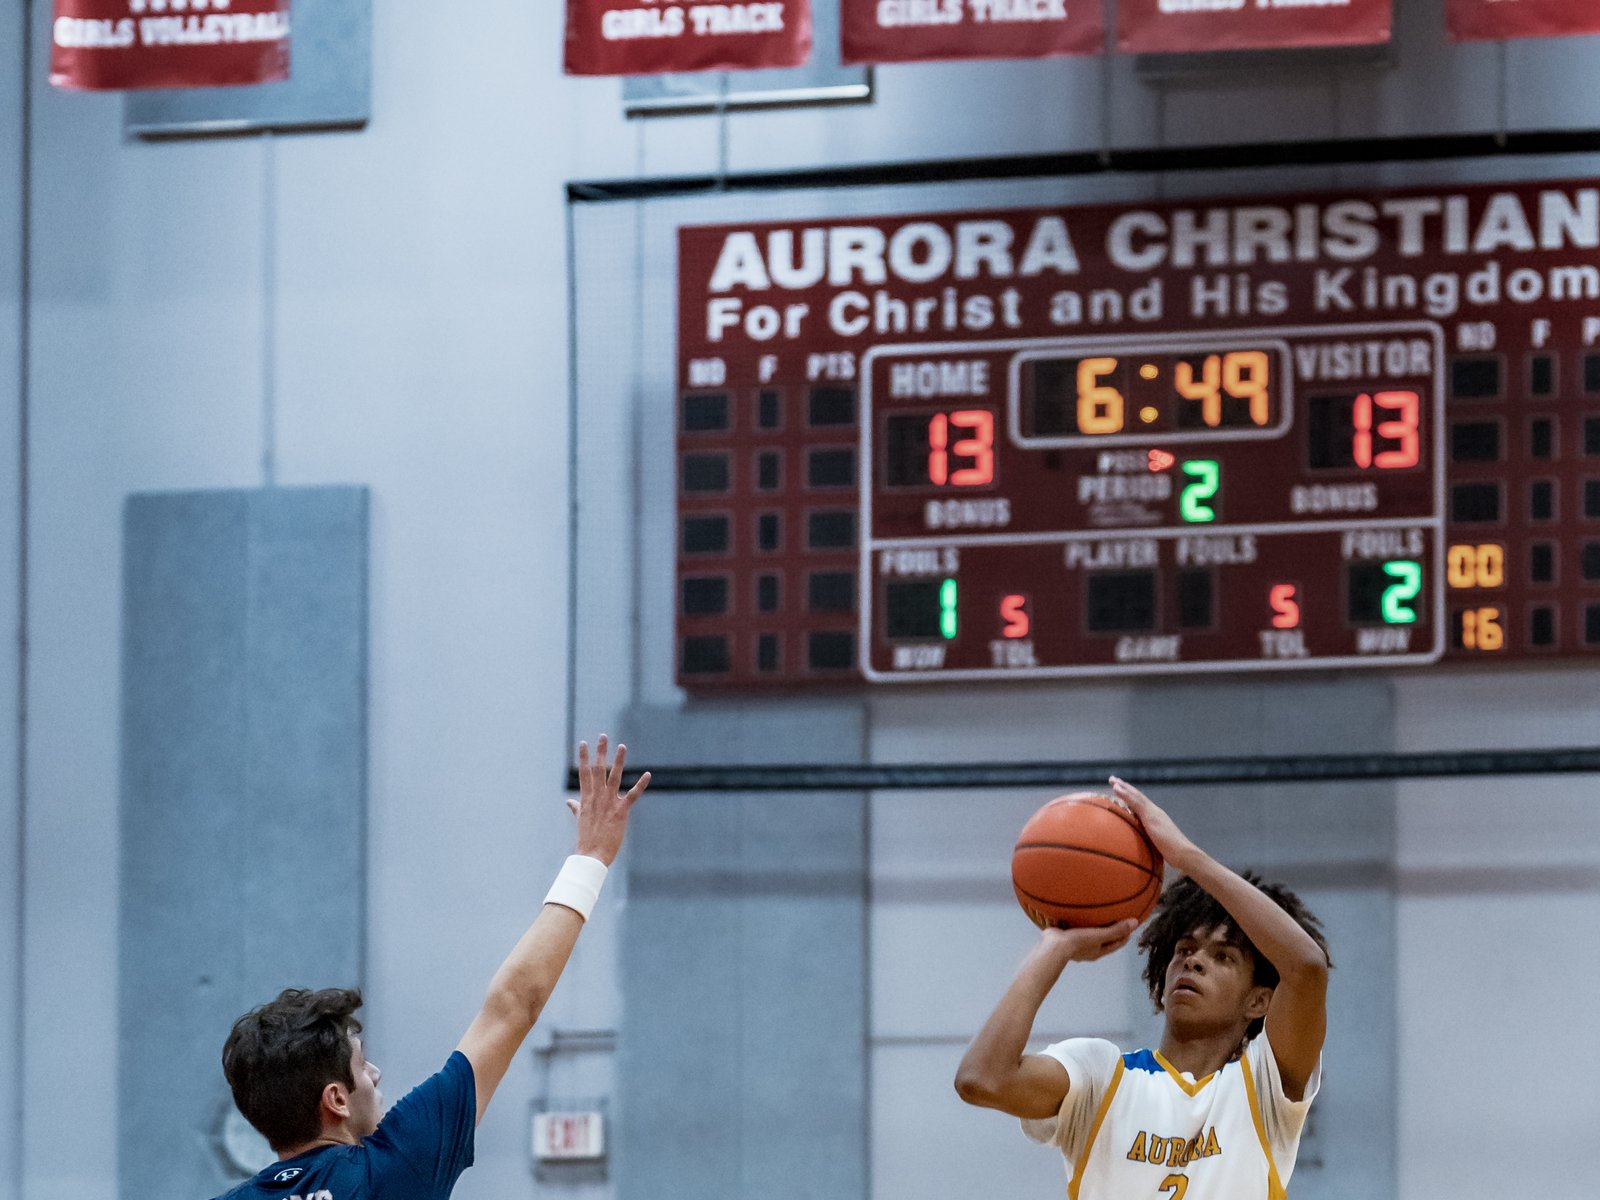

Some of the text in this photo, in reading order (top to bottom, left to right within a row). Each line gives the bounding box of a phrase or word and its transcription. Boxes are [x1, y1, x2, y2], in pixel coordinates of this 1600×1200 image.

[53, 16, 135, 48] GIRLS
[601, 3, 784, 40] GIRLS TRACK
[876, 0, 1067, 27] GIRLS TRACK
[709, 190, 1600, 292] AURORA CHRISTIAN
[706, 262, 1600, 342] For Christ and His Kingdom
[758, 354, 778, 383] F
[889, 360, 991, 397] HOME
[1298, 341, 1431, 379] VISITOR
[1076, 351, 1270, 435] 6:49
[928, 410, 995, 486] 13
[1352, 391, 1420, 470] 13
[1079, 474, 1171, 504] PERIOD
[1180, 460, 1220, 523] 2
[1290, 483, 1379, 514] BONUS
[927, 499, 1010, 528] BONUS
[880, 547, 961, 577] FOULS
[1065, 538, 1160, 570] PLAYER
[1341, 529, 1424, 560] FOULS
[1447, 544, 1504, 589] 00
[939, 578, 958, 640] 1
[1381, 560, 1423, 625] 2
[1462, 607, 1504, 651] 16
[1127, 1126, 1222, 1168] AURORA
